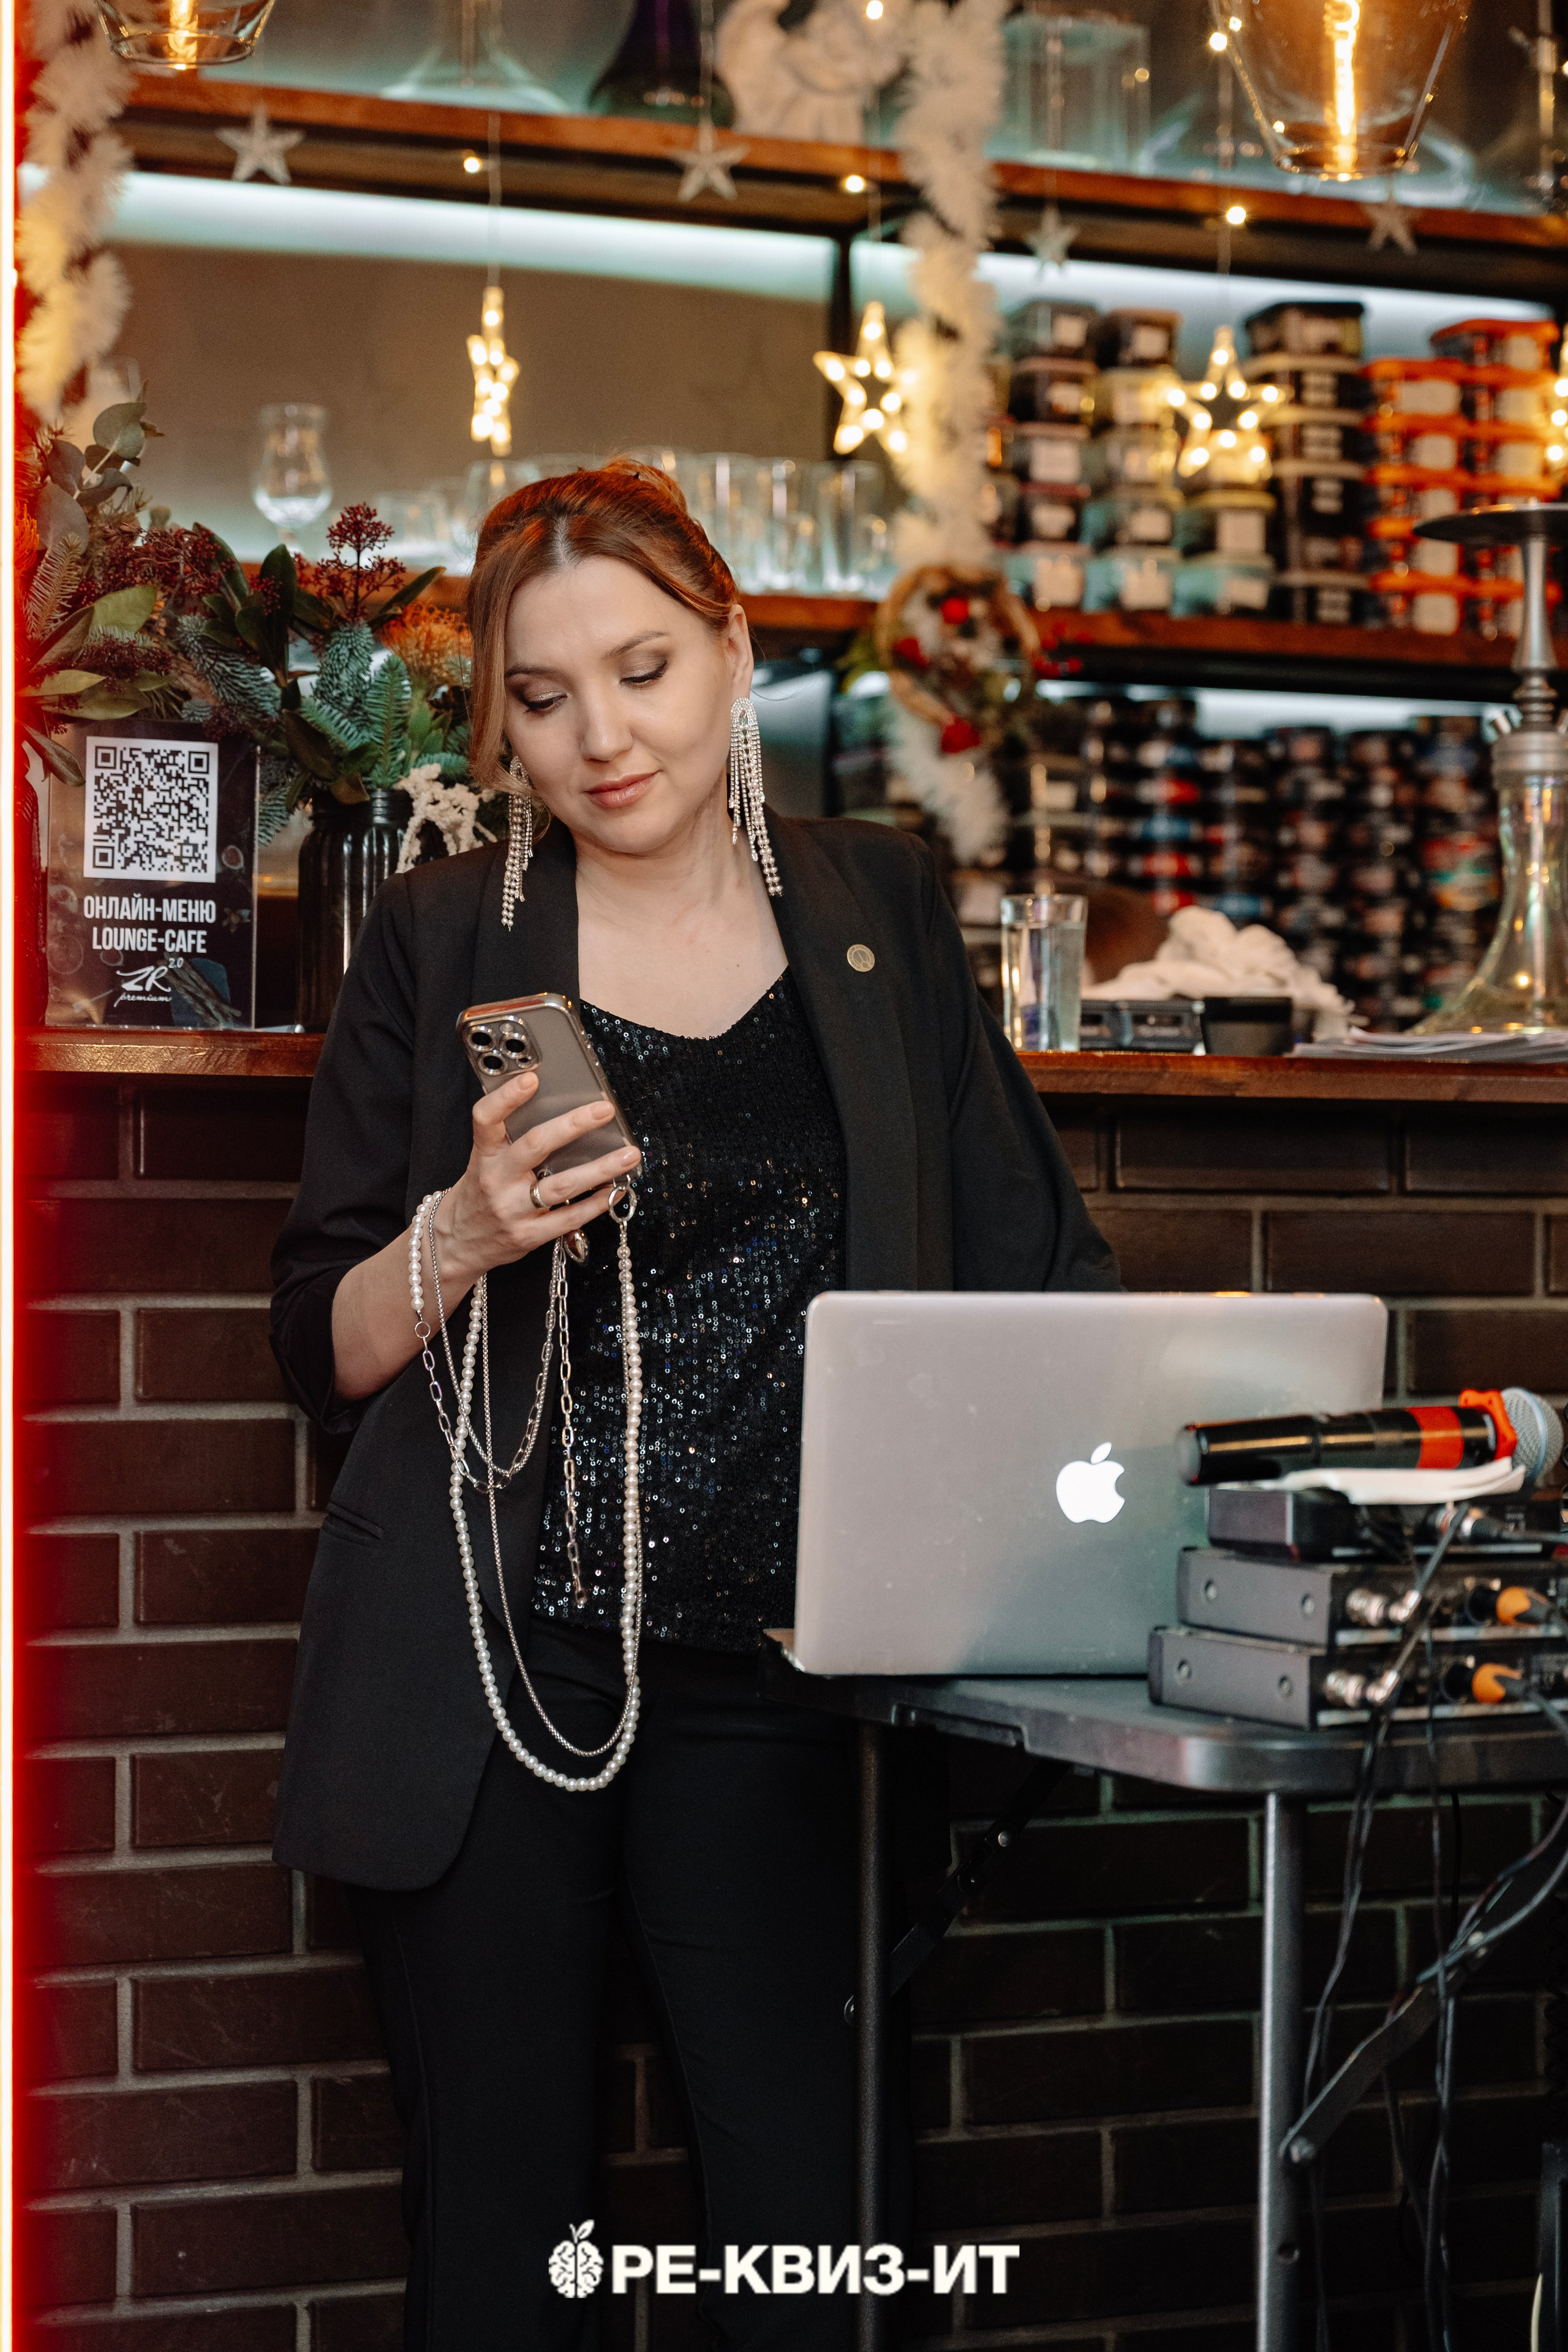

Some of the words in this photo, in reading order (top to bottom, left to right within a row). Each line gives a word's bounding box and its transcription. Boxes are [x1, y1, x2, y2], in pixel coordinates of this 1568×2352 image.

[83, 893, 216, 924] ОНЛАЙН-МЕНЮ
[92, 927, 207, 953] LOUNGE-CAFE
[113, 992, 172, 1008] premium
